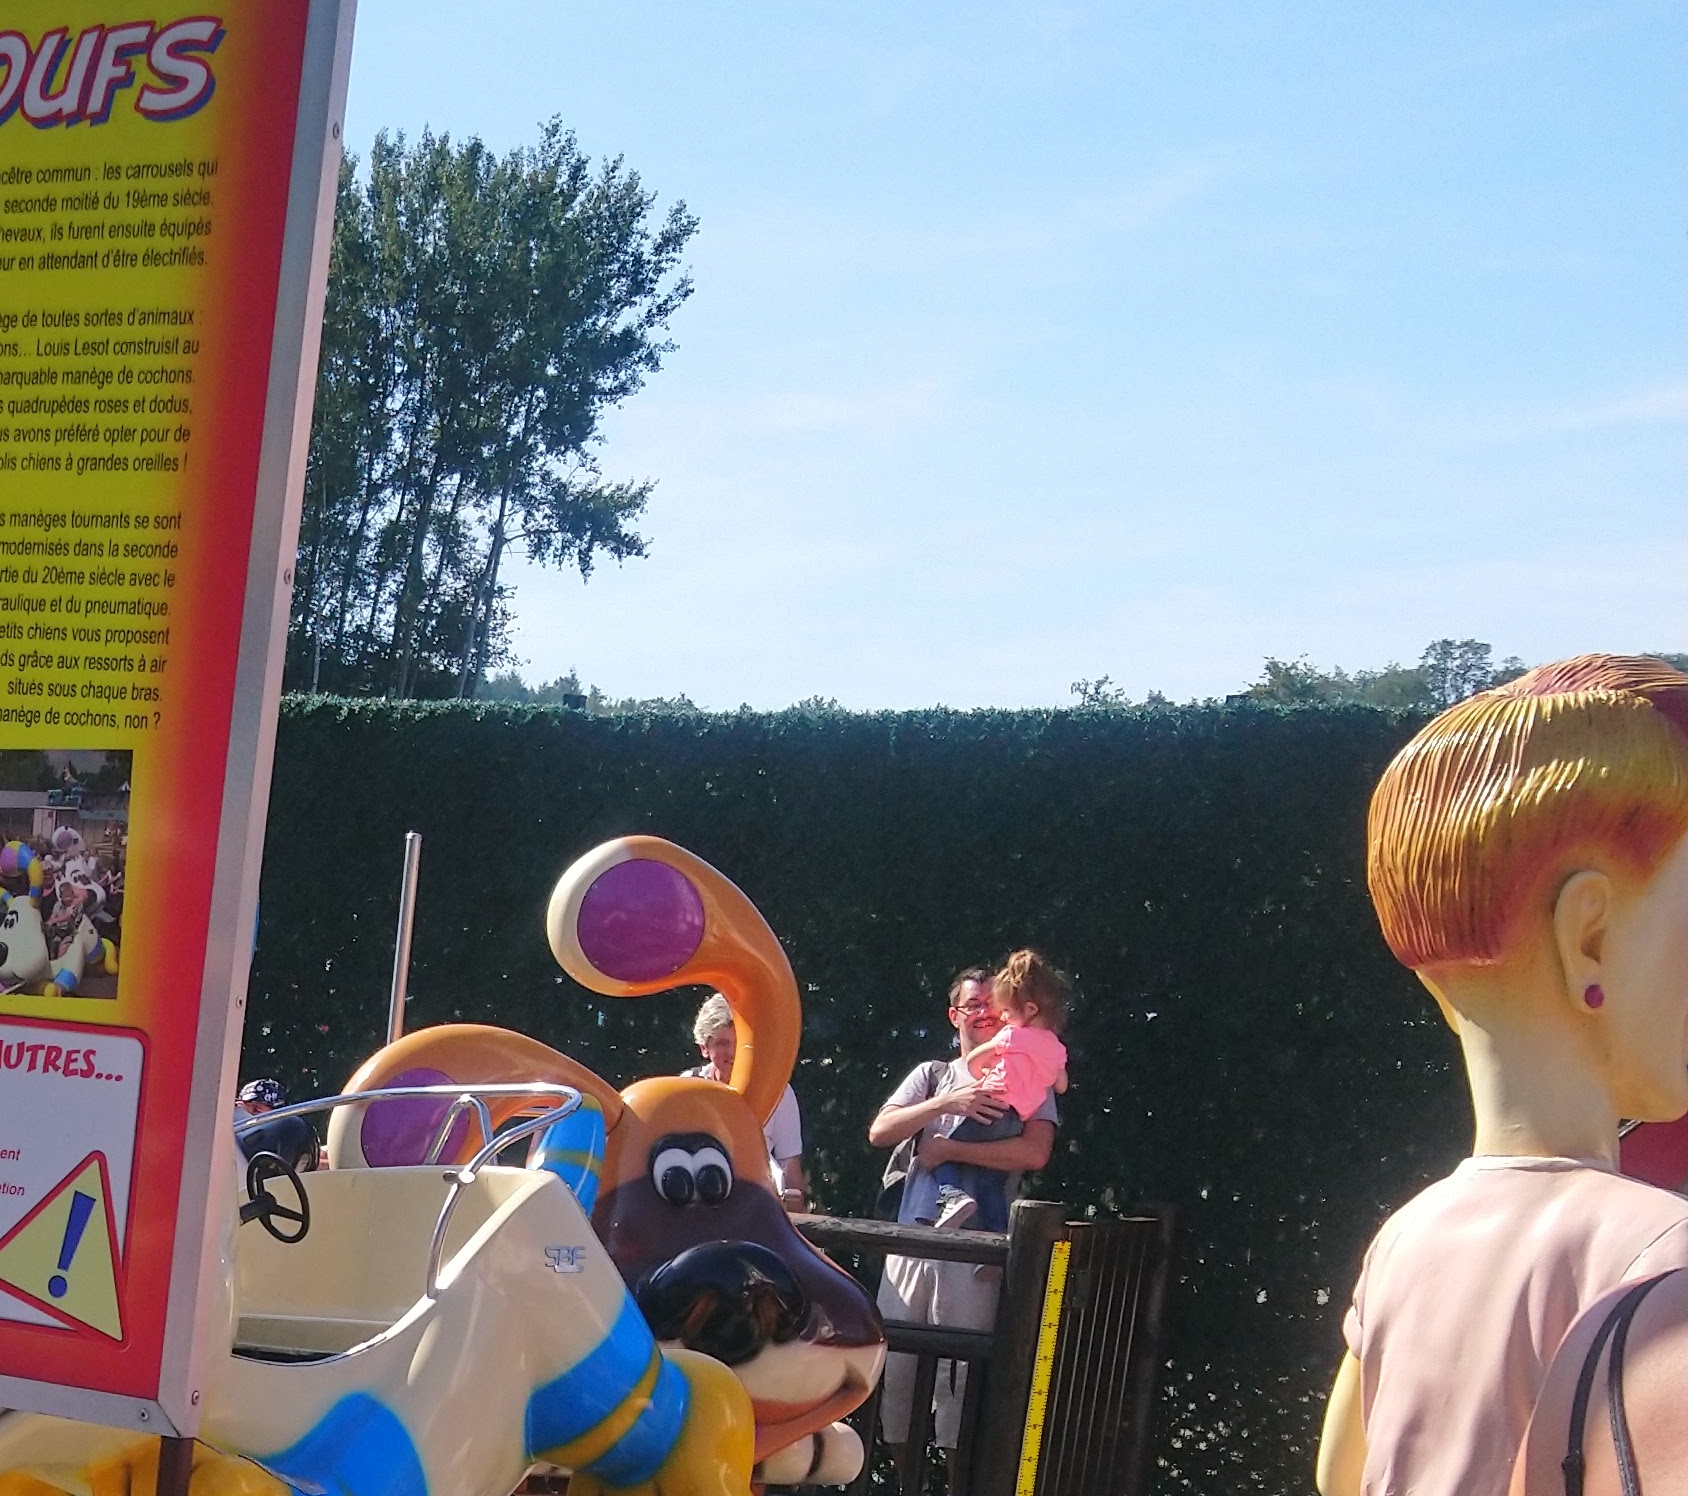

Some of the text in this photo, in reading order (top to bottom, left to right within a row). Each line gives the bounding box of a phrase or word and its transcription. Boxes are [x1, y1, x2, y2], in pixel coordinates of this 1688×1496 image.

[36, 167, 91, 183] commun
[103, 162, 121, 180] les
[126, 159, 193, 179] carrousels
[198, 160, 218, 180] qui
[37, 338, 70, 356] Louis
[113, 336, 179, 355] construisit
[183, 340, 199, 354] au
[62, 367, 113, 390] manège
[118, 365, 133, 384] de
[138, 366, 194, 384] cochons.
[8, 395, 90, 418] quadrupèdes
[94, 399, 129, 413] roses
[133, 396, 145, 413] et
[149, 394, 192, 414] dodus,
[14, 428, 50, 442] avons
[55, 423, 99, 446] préféré
[104, 425, 137, 447] opter
[140, 428, 170, 446] pour
[174, 424, 190, 442] de
[21, 453, 61, 471] chiens
[65, 453, 73, 470] à
[77, 453, 128, 475] grandes
[133, 453, 179, 471] oreilles
[10, 510, 66, 532] manèges
[72, 511, 130, 528] tournants
[134, 515, 149, 529] se
[153, 512, 181, 529] sont
[19, 650, 53, 671] grâce
[57, 656, 80, 669] aux
[84, 655, 134, 672] ressorts
[138, 654, 146, 672] à
[150, 656, 167, 673] air
[45, 707, 60, 724] de
[64, 709, 119, 729] cochons,
[125, 715, 148, 729] non
